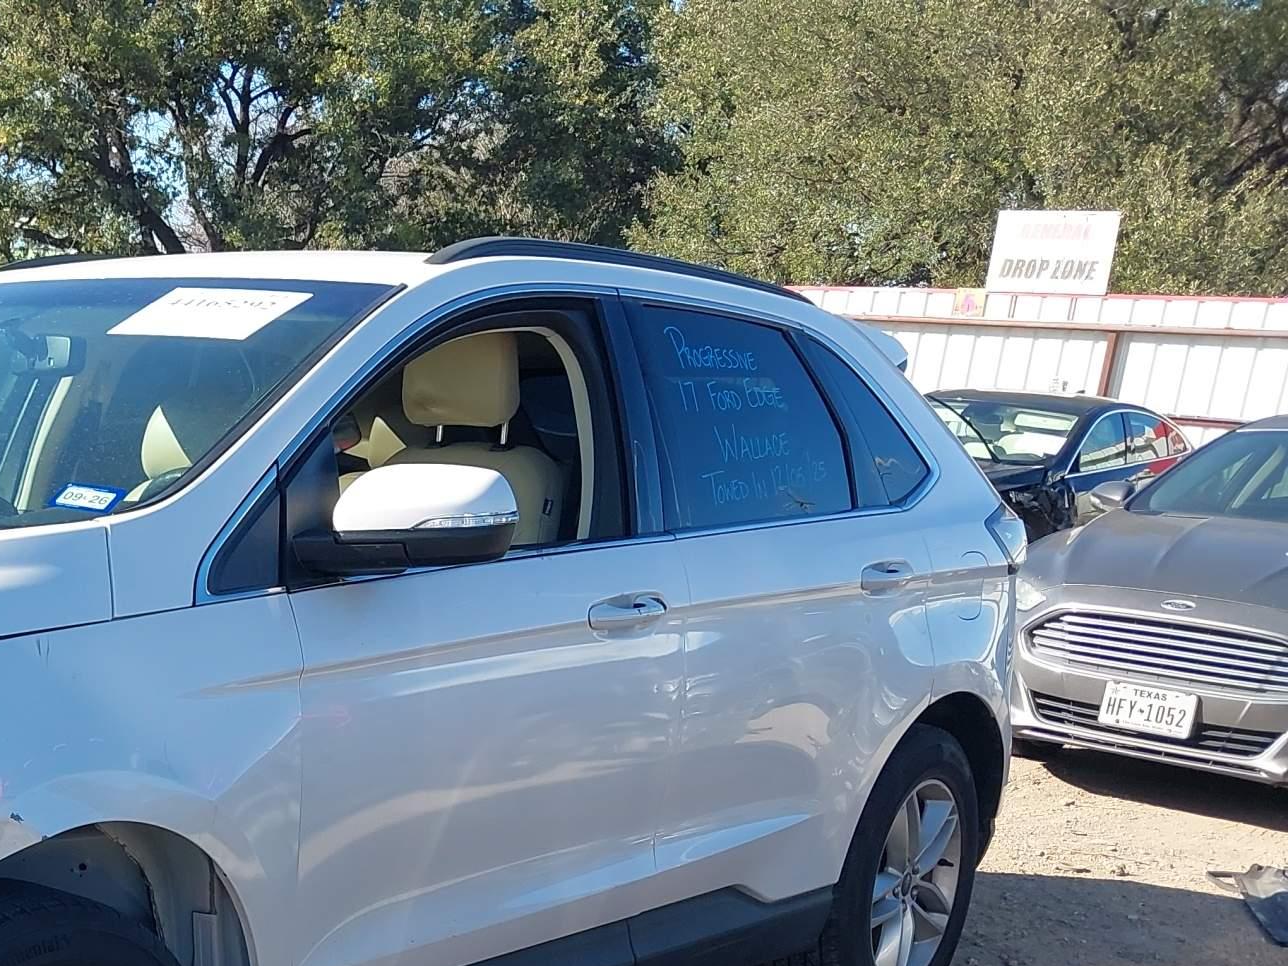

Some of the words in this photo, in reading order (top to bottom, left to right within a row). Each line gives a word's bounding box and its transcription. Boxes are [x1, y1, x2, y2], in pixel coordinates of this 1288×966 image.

[998, 257, 1050, 279] DROP
[1050, 260, 1100, 281] ZONE
[663, 325, 758, 371] PROGRESSIVE
[677, 379, 700, 413] 17
[705, 380, 743, 412] FORD
[742, 376, 786, 409] EDGE
[713, 423, 791, 463] WALLACE
[700, 469, 750, 507] TOWED
[1133, 688, 1168, 702] TEXAS
